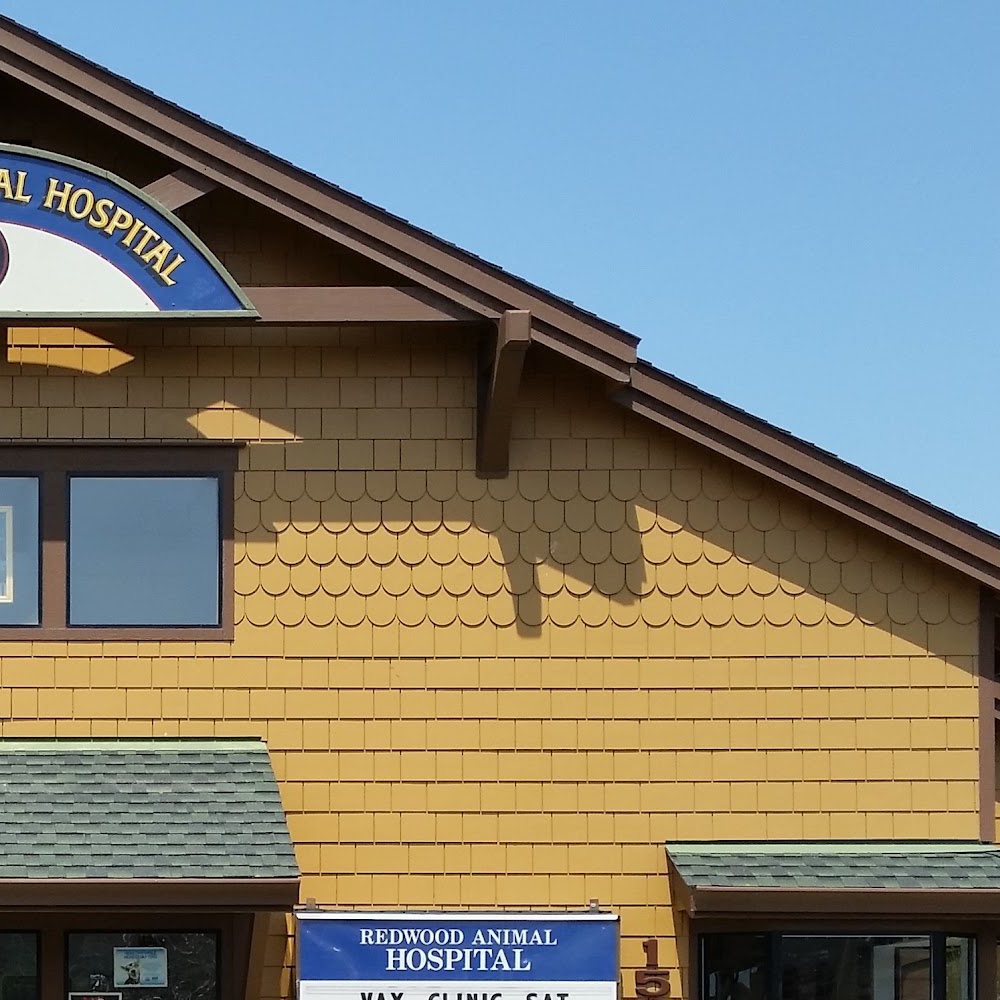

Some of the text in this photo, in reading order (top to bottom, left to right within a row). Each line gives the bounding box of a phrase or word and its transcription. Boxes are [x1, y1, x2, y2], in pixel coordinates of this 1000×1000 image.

[43, 178, 185, 286] HOSPITAL
[359, 928, 558, 945] REDWOOD ANIMAL
[386, 948, 531, 971] HOSPITAL
